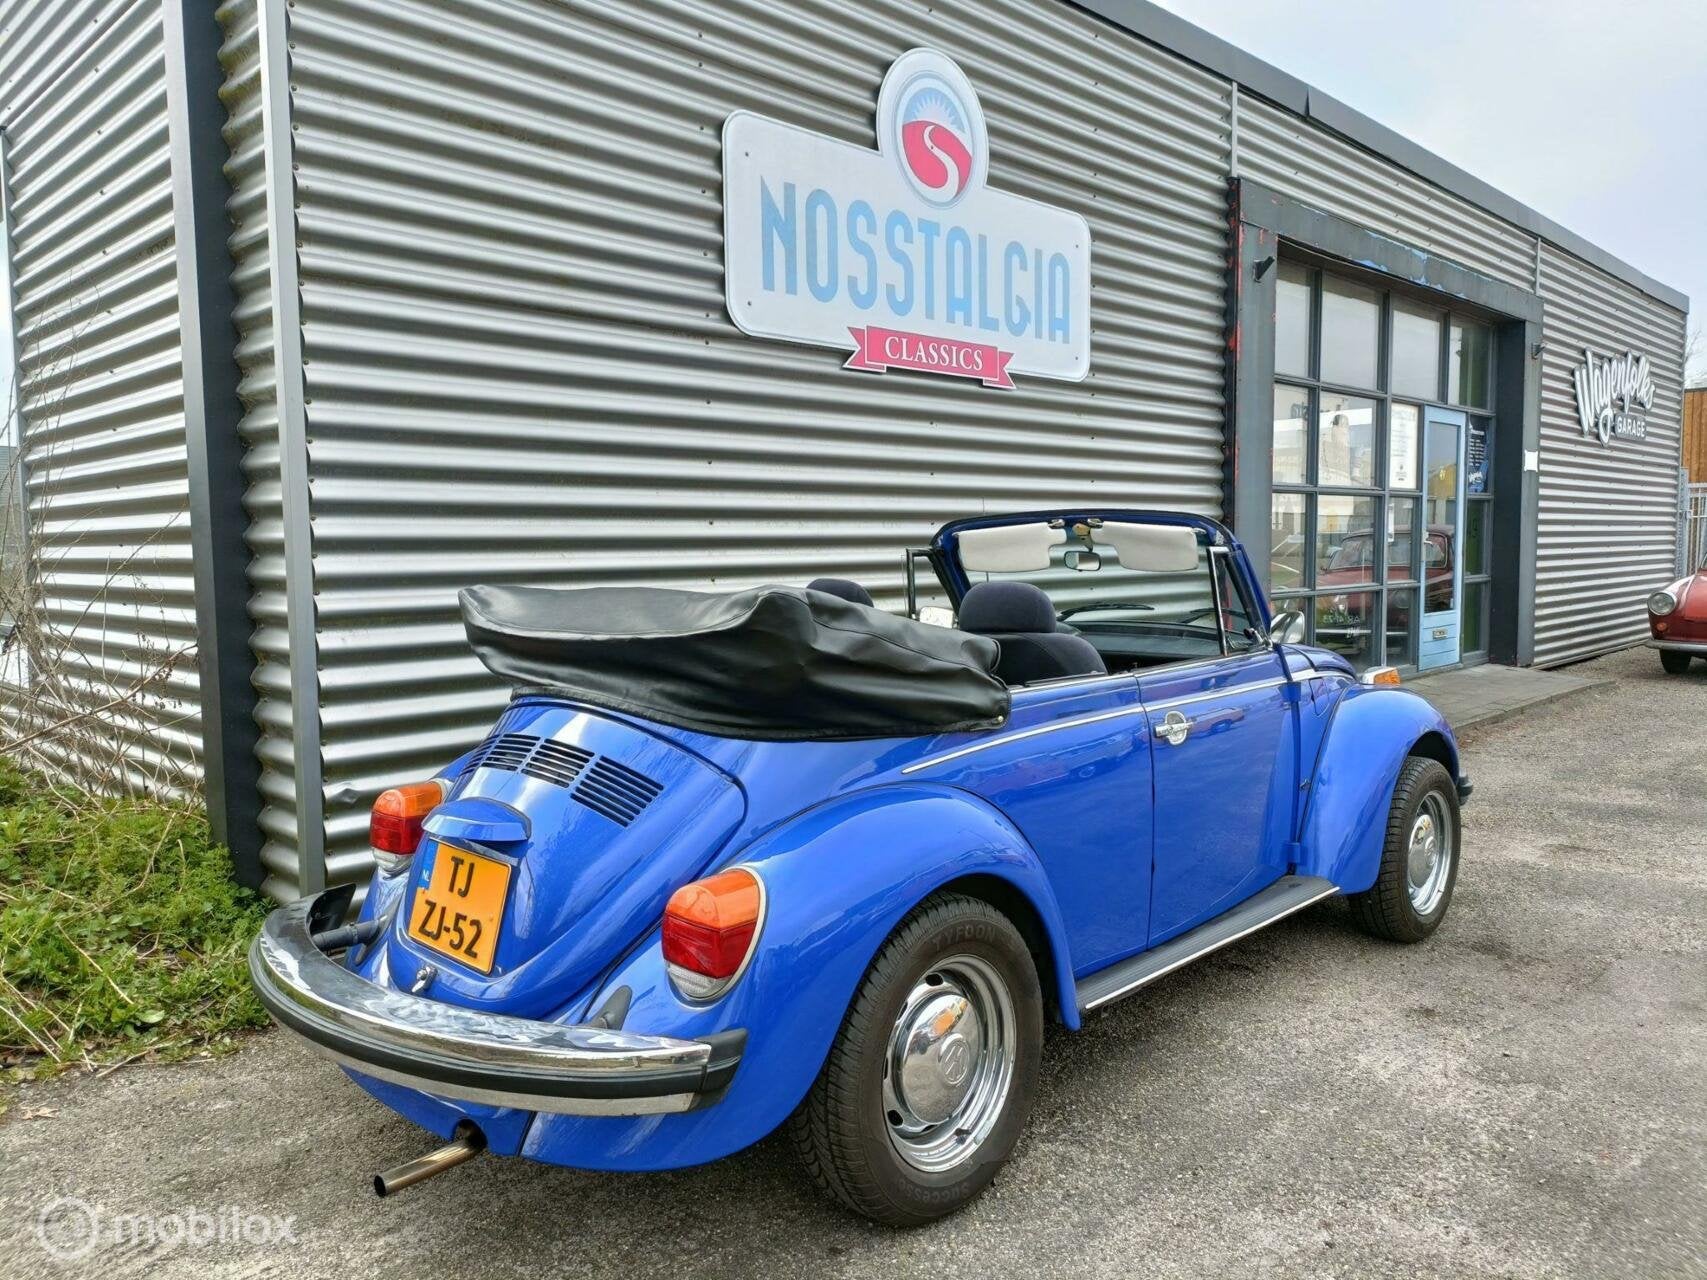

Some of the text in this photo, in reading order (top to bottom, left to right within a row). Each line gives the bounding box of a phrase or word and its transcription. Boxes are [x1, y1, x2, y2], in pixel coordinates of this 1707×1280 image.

[760, 175, 1071, 344] NOSSTALGIA
[884, 336, 983, 371] CLASSICS
[1617, 416, 1645, 438] GARAGE
[448, 856, 475, 898] TJ
[418, 900, 482, 959] ZJ-52
